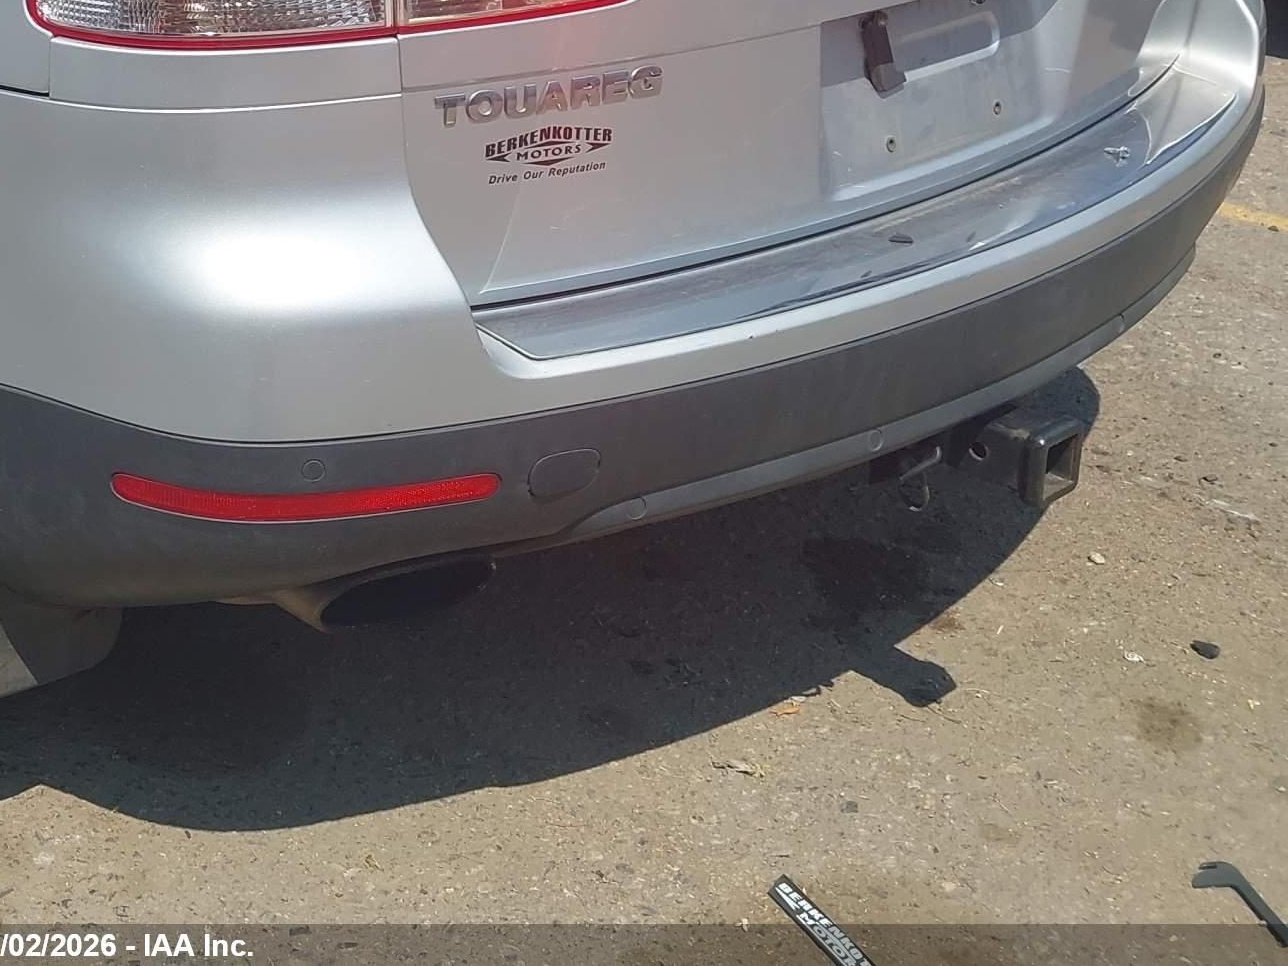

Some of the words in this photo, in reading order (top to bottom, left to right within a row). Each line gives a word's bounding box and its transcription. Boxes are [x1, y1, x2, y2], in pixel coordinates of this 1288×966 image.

[434, 65, 664, 129] TOUAREG
[485, 126, 613, 158] BERKENKOTTER
[516, 144, 582, 161] MOTORS
[488, 173, 519, 185] Drive
[523, 169, 544, 180] Our
[548, 161, 606, 178] Reputation
